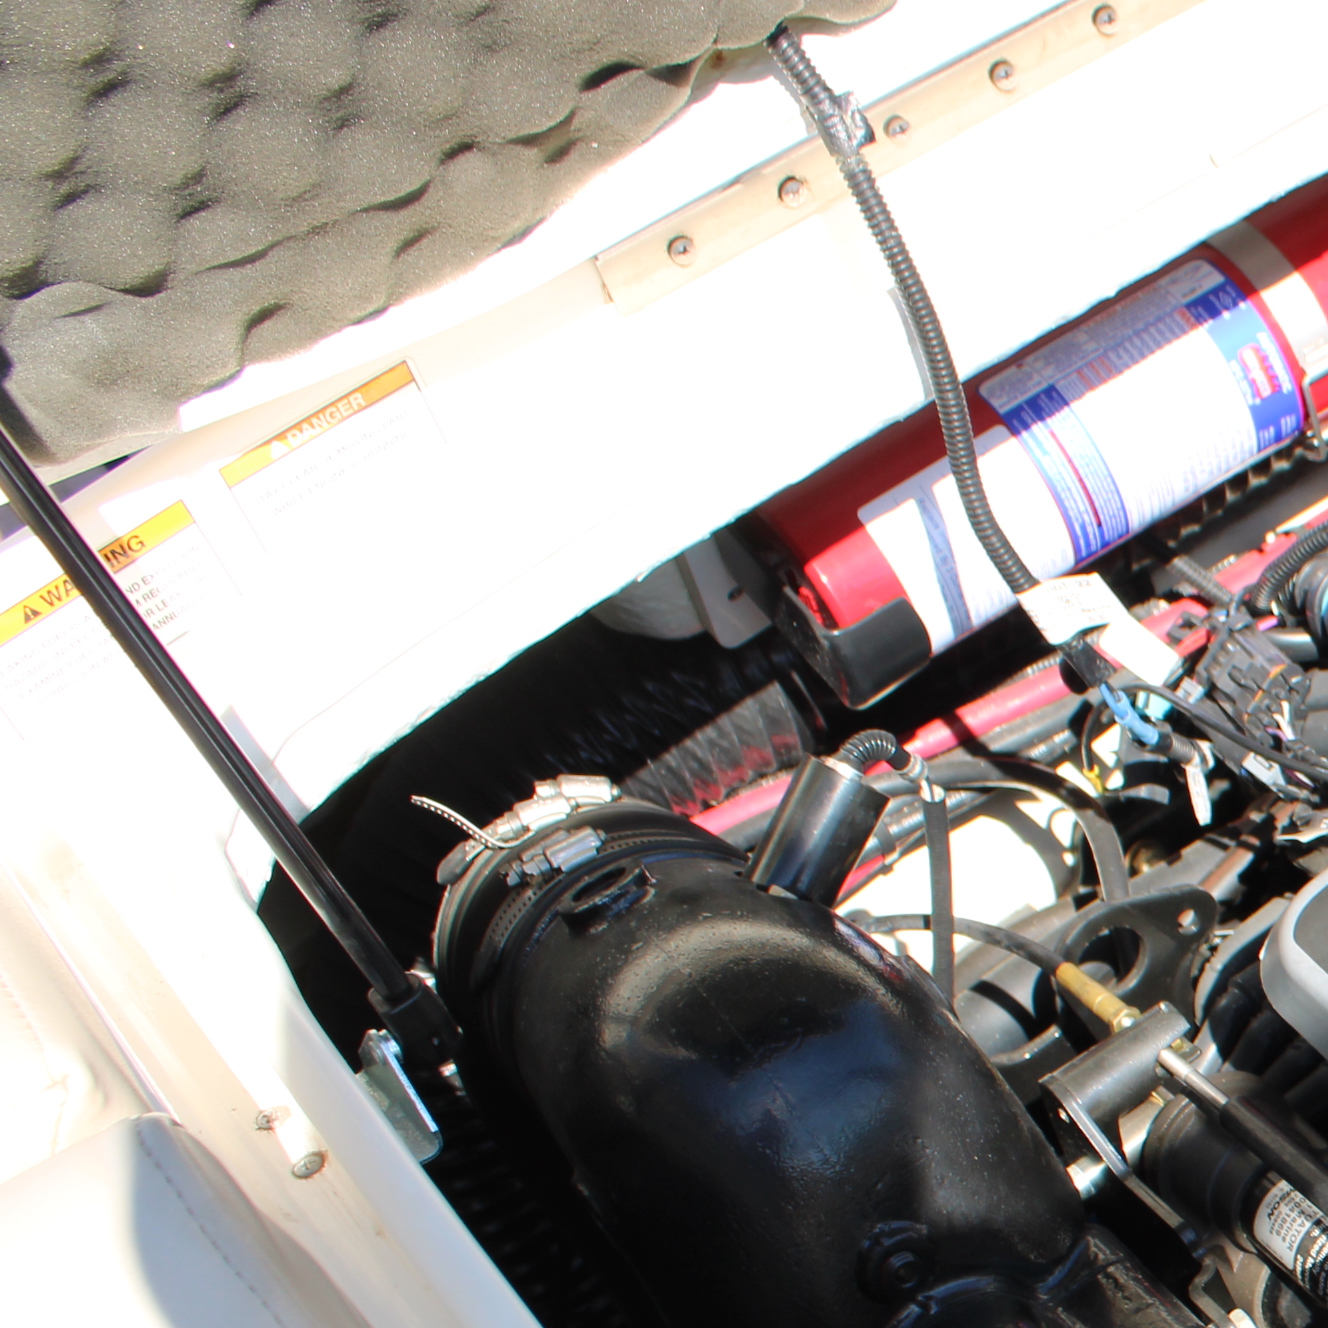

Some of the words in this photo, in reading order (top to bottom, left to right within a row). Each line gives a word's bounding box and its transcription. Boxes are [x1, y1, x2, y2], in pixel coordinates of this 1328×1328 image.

[286, 393, 366, 447] DANGER
[41, 535, 146, 608] WAING
[1278, 1208, 1305, 1243] Marine
[1283, 1206, 1318, 1253] TUATOR
